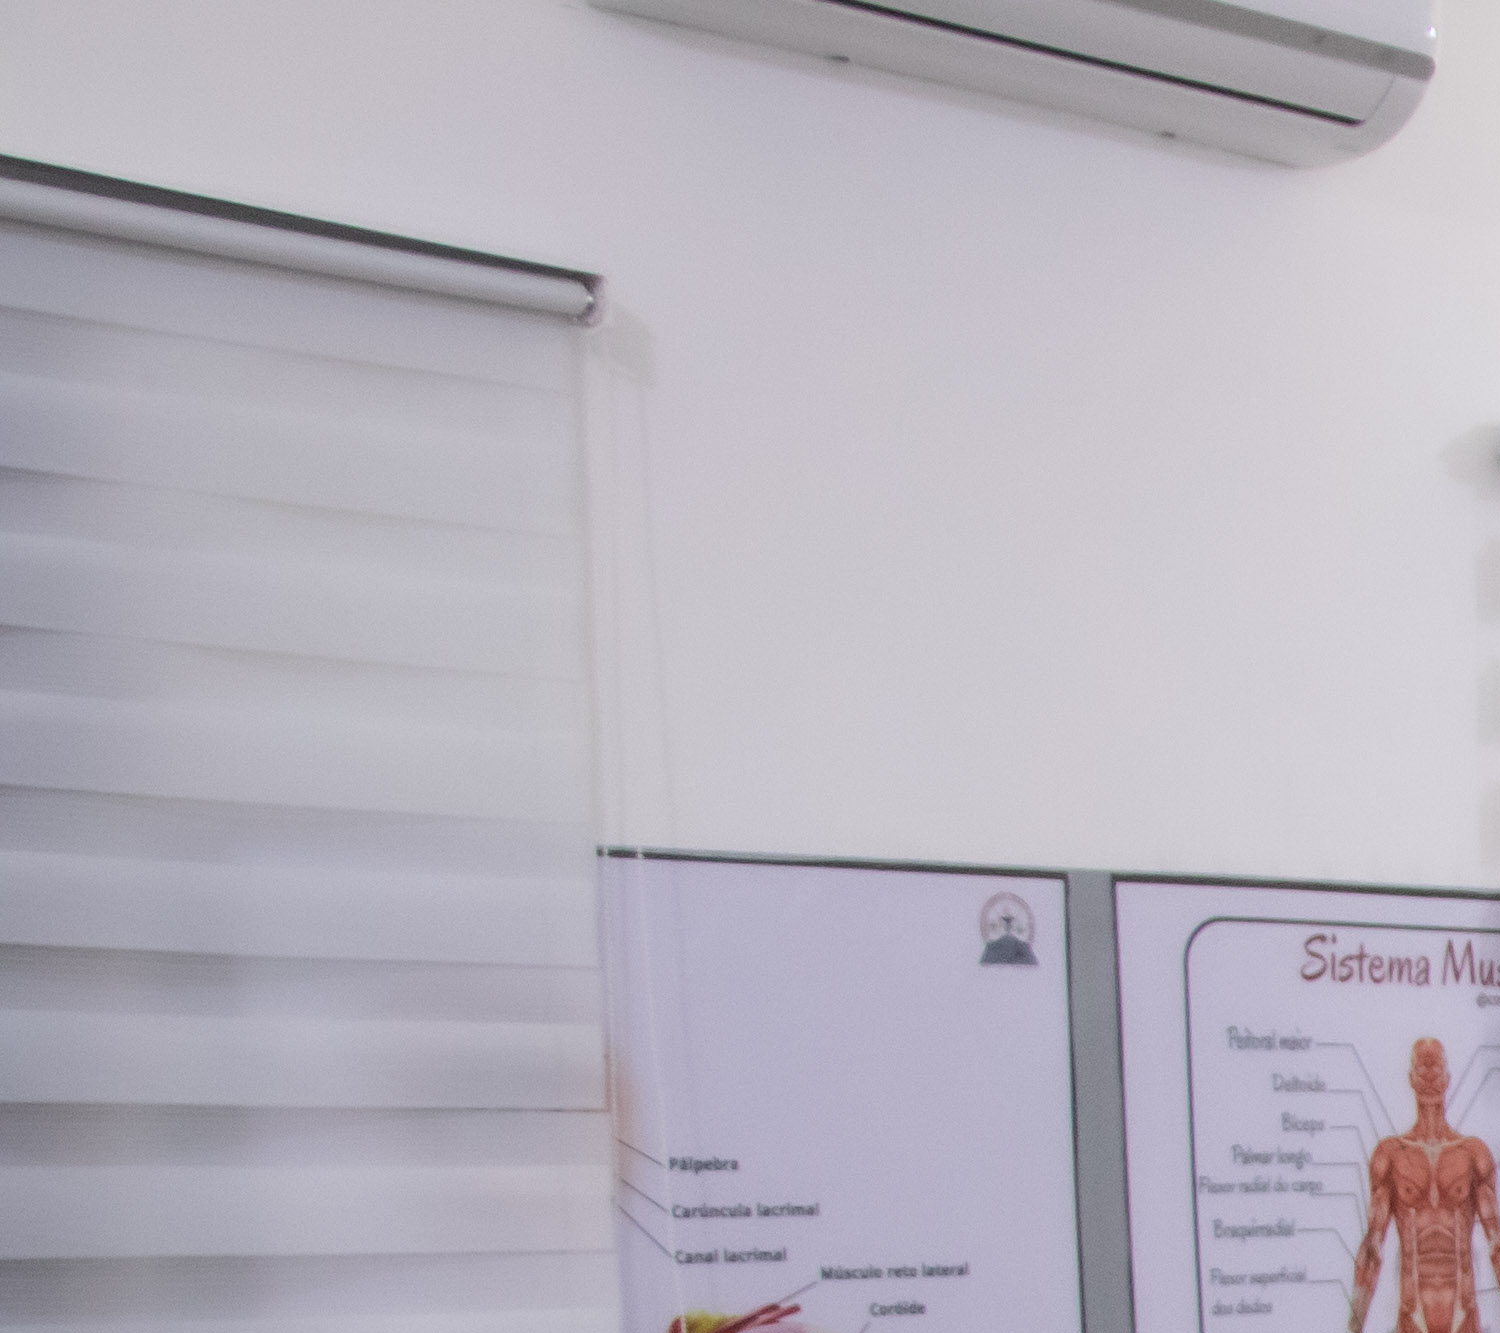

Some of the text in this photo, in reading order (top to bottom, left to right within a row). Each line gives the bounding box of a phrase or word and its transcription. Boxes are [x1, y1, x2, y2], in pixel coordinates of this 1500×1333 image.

[1300, 933, 1430, 986] Sistema
[757, 1202, 819, 1216] lacrimal
[676, 1247, 786, 1263] Canal lacrimal
[888, 1267, 917, 1278] reto
[922, 1261, 968, 1277] lateral
